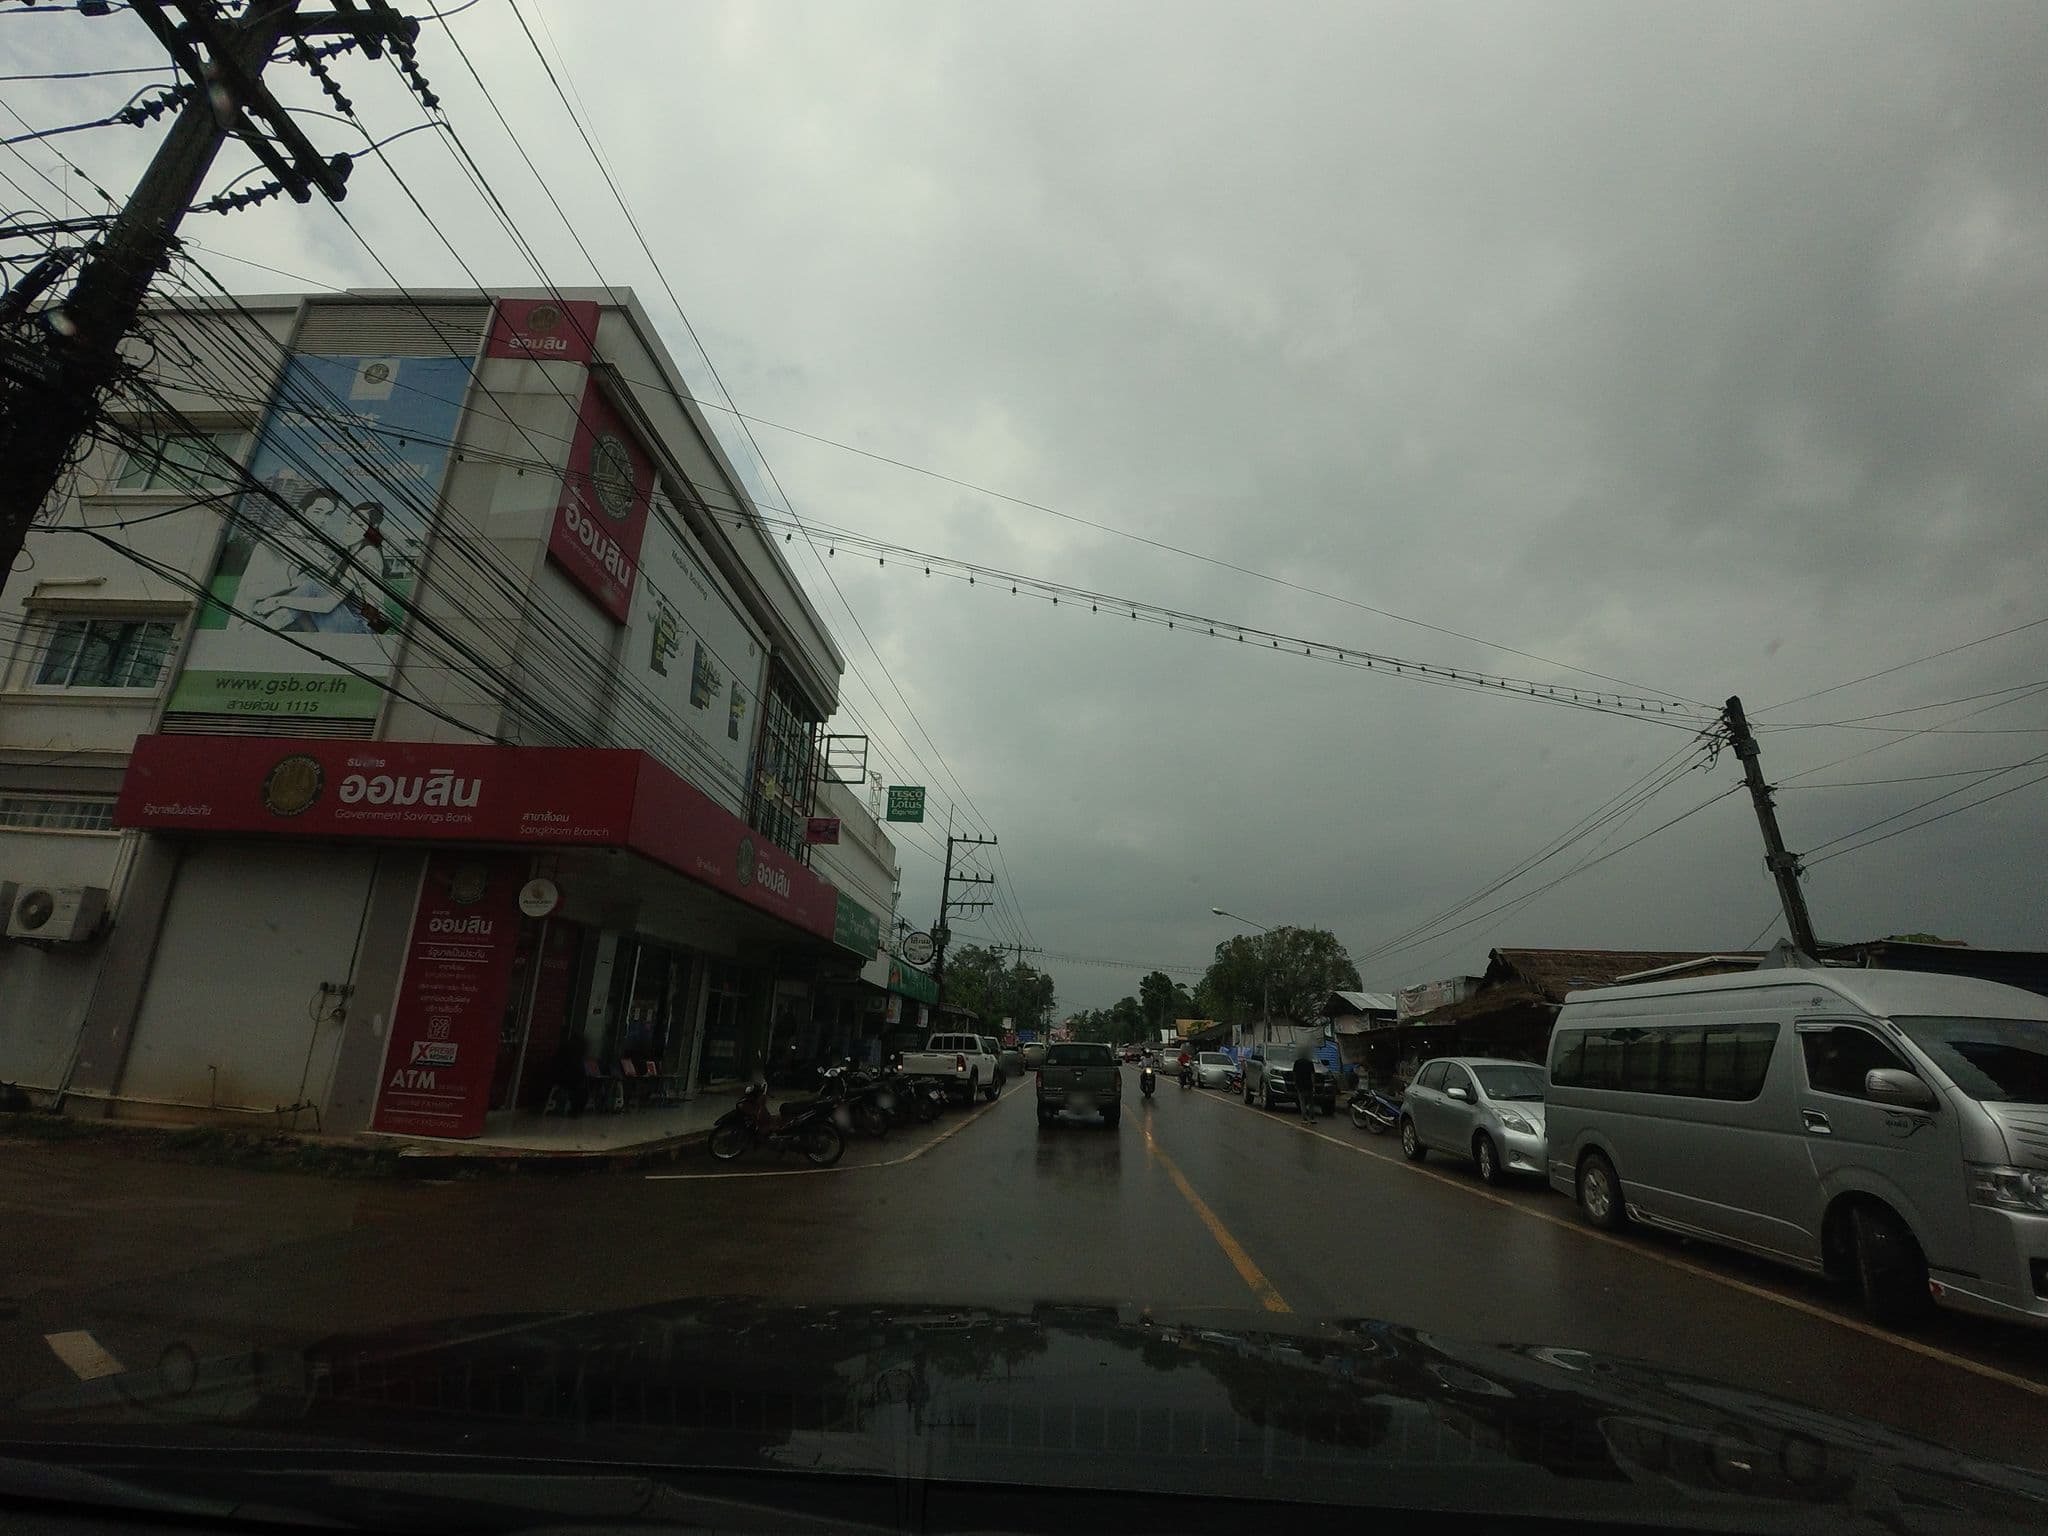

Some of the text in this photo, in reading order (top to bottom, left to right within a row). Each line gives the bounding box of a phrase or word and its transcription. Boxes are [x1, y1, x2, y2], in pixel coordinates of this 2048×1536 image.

[565, 502, 631, 587] ออมสิน
[215, 676, 348, 695] www.gsb.or.th
[286, 700, 320, 713] 1115
[339, 768, 482, 808] ออมสิน
[890, 790, 923, 798] TESCO
[891, 798, 922, 809] Lotus
[335, 808, 474, 825] Government Savings Bank
[573, 827, 610, 837] Branch
[756, 862, 791, 898] ออมสิน
[428, 915, 494, 935] ออมสิน
[389, 1068, 437, 1089] ATM
